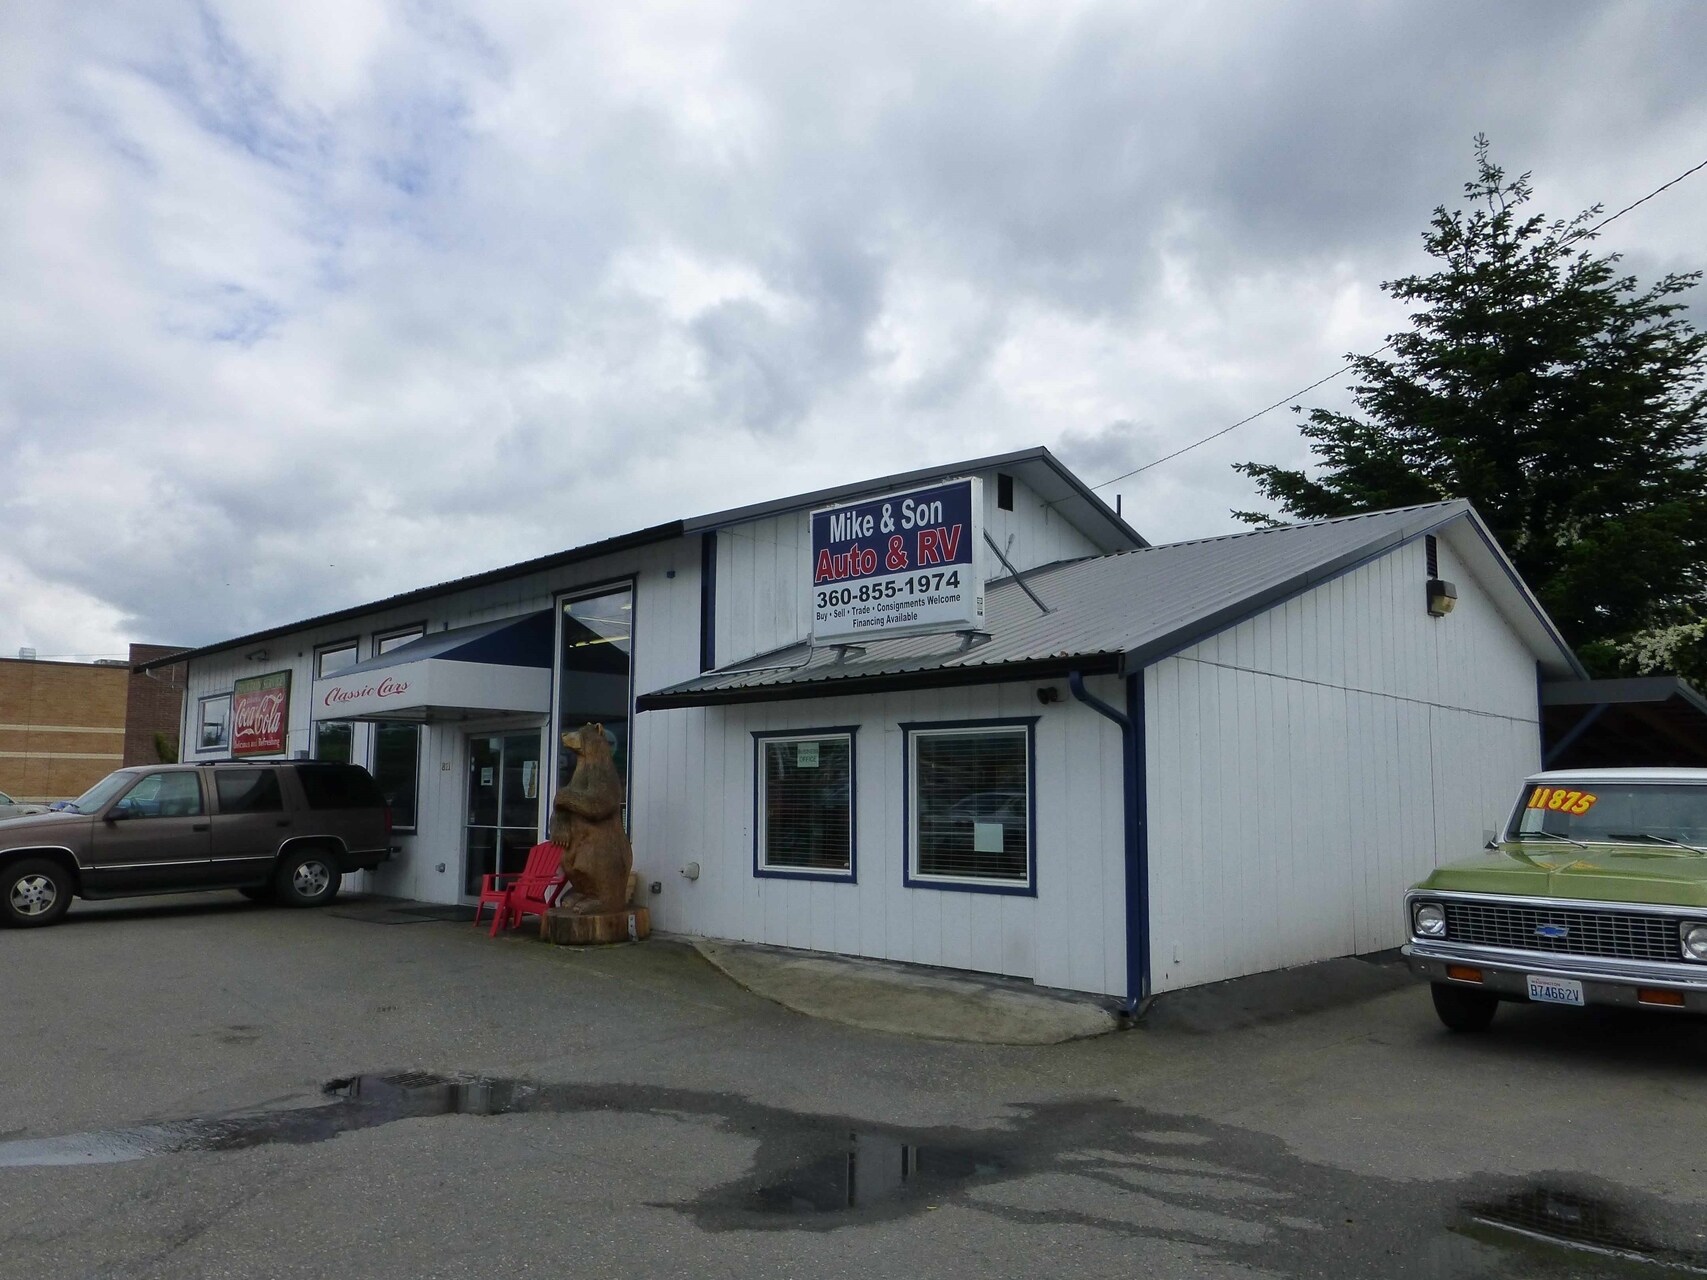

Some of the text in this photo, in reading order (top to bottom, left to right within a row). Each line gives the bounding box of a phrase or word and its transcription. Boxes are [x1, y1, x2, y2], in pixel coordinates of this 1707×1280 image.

[830, 499, 942, 543] Mike & Son
[815, 524, 962, 583] Auto & RV
[817, 570, 960, 609] 360-855-1974
[816, 593, 961, 622] Buy Sell Trade Consignments Welcome
[852, 612, 918, 629] Financing Available
[324, 677, 410, 706] Classic Cars
[1528, 788, 1598, 815] 11875
[1531, 984, 1579, 1001] B74662V
